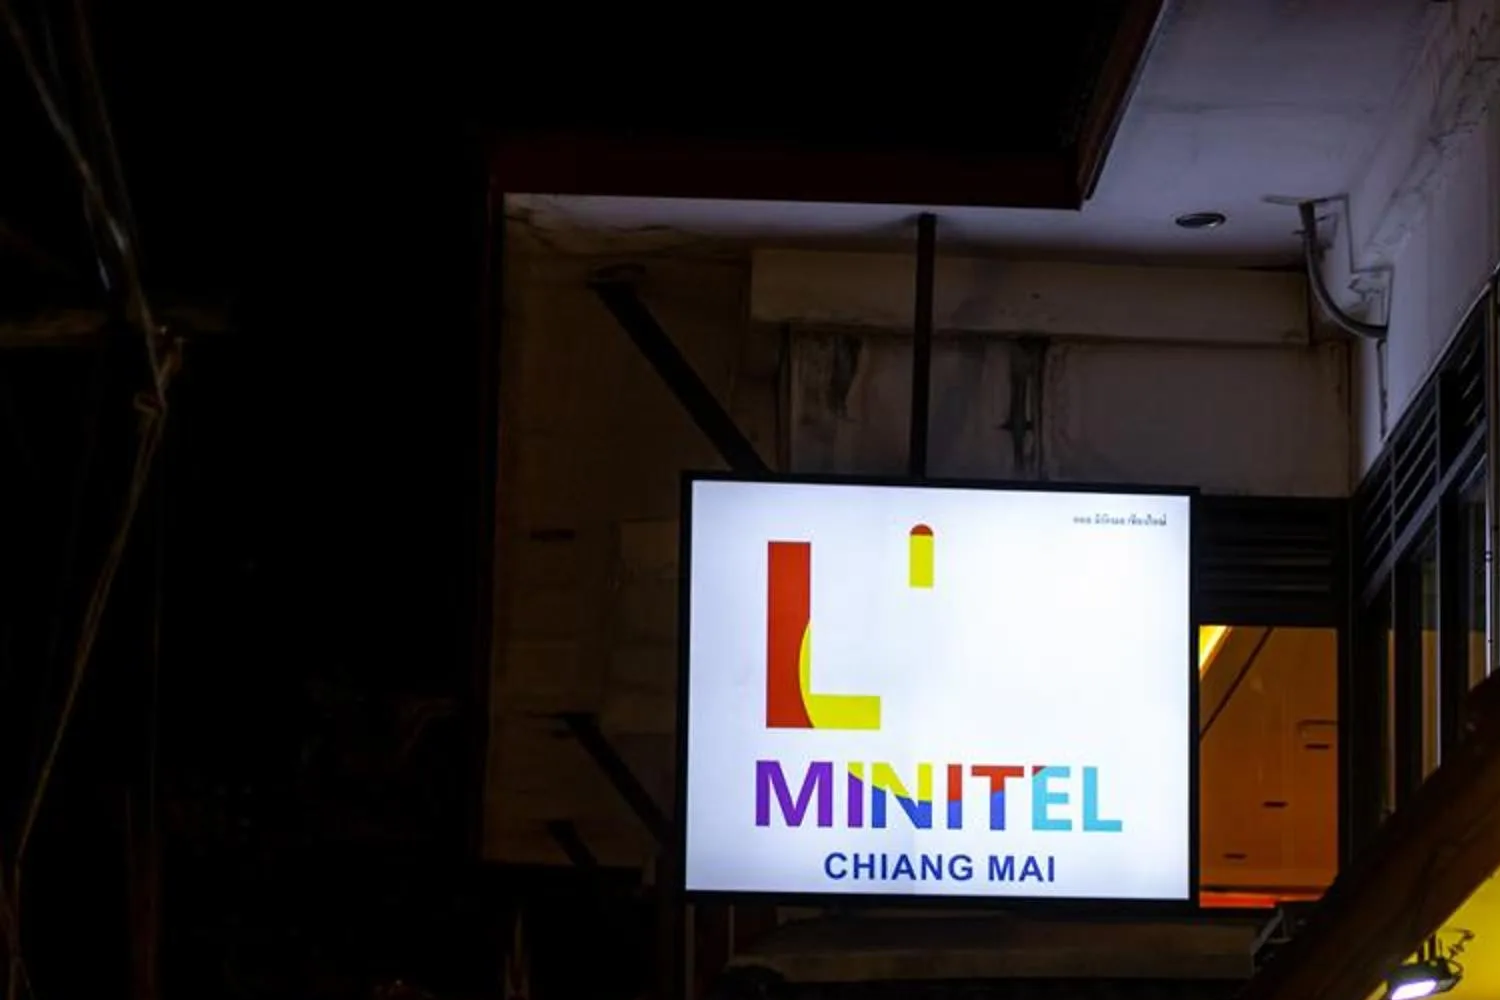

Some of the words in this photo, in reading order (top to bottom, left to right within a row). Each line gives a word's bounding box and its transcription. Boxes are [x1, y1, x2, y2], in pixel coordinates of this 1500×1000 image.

[755, 760, 1123, 832] MINITEL
[824, 852, 974, 882] CHIANG
[988, 855, 1056, 883] MAI
